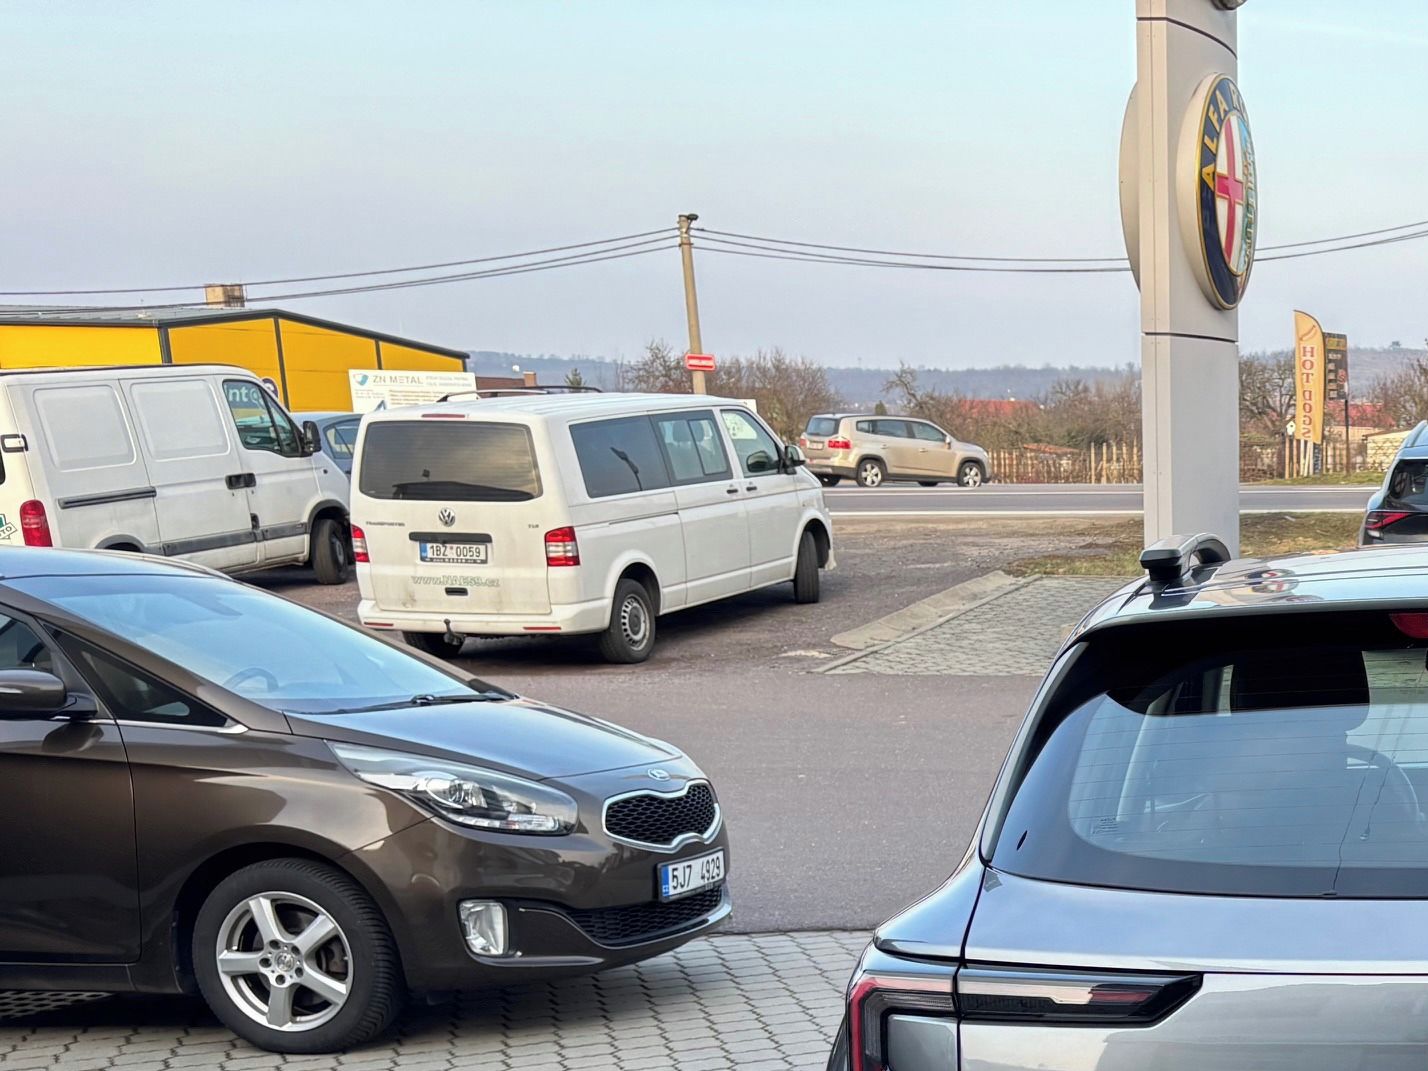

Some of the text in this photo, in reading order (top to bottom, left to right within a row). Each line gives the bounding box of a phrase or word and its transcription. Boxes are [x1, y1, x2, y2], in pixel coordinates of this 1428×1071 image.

[1202, 90, 1229, 191] ALFA
[389, 376, 425, 385] METAL
[430, 545, 481, 558] 1BZ 0059
[671, 856, 721, 890] 5J7 4929
